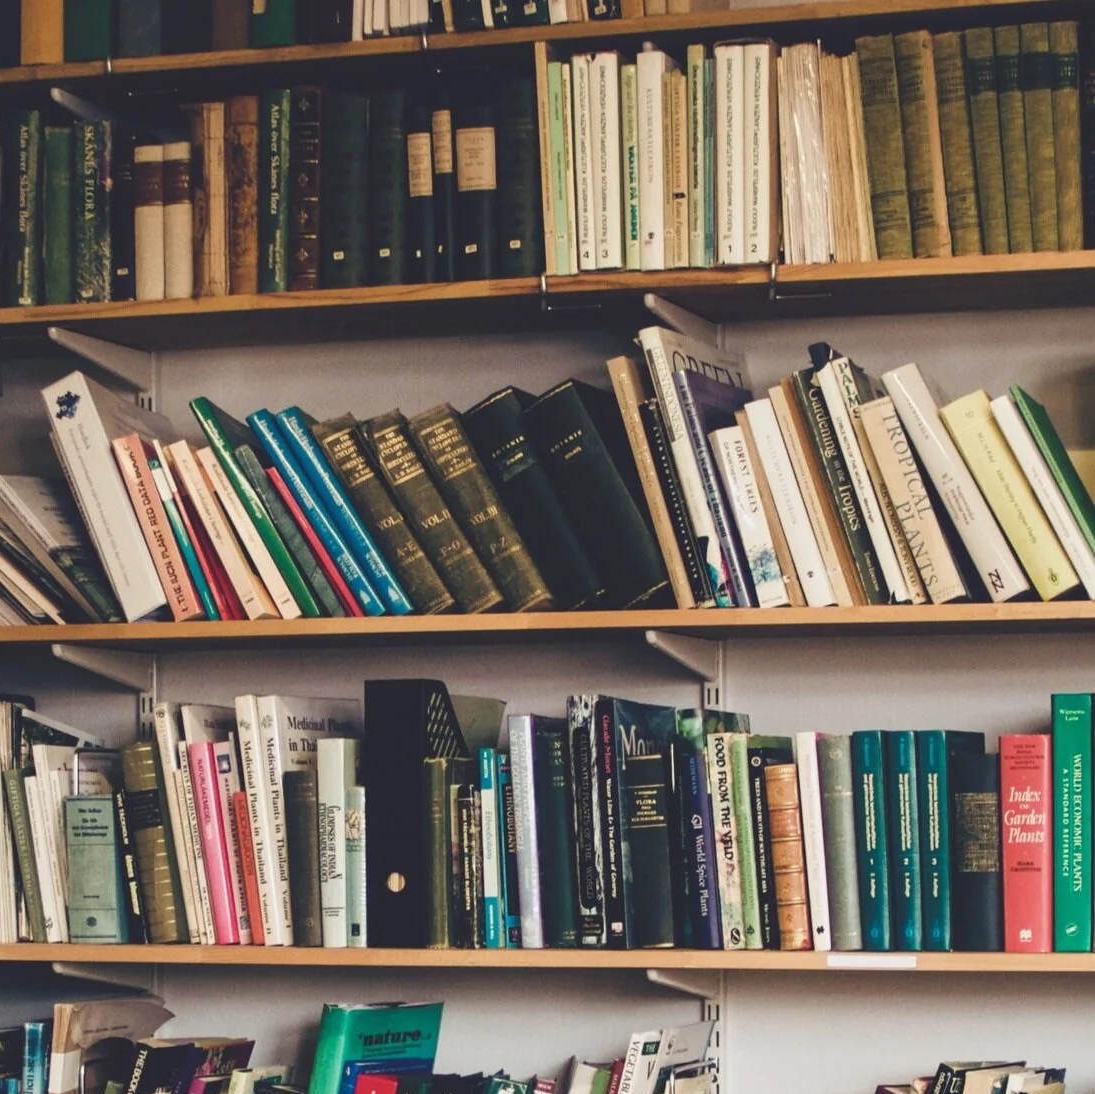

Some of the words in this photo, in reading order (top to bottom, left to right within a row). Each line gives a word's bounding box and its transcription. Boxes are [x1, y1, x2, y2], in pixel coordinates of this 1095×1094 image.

[270, 104, 280, 127] Atlas
[19, 125, 28, 148] Atlas
[85, 126, 95, 175] SKÅNES
[270, 131, 279, 152] över
[19, 151, 27, 171] över
[270, 155, 281, 189] Skånes
[19, 175, 29, 207] Skånes
[85, 179, 94, 220] FLORA
[270, 192, 280, 214] flora
[19, 210, 28, 232] flora
[804, 388, 840, 459] Gardening
[733, 440, 750, 477] FOREST
[744, 483, 758, 513] TREES
[836, 469, 847, 482] the
[881, 410, 932, 521] TROPICAL
[137, 480, 150, 505] DATA
[146, 507, 158, 526] RED
[838, 484, 864, 531] Tropics
[154, 529, 169, 559] PLANT
[894, 501, 938, 588] PLANTS
[287, 716, 328, 730] Medicinal
[602, 715, 611, 744] Claude
[243, 741, 257, 790] Medicinal
[266, 737, 279, 786] Medicinal
[714, 737, 725, 767] FOOD
[1073, 754, 1082, 792] WORLD
[185, 784, 191, 795] OF
[717, 772, 730, 803] FROM
[1009, 786, 1041, 802] Index
[248, 793, 260, 823] Plants
[271, 790, 283, 822] Plants
[506, 786, 515, 853] ETHNOBOTANY
[721, 806, 731, 828] THE
[1004, 811, 1045, 826] Garden
[251, 826, 260, 837] in
[274, 824, 283, 834] in
[326, 805, 341, 843] GLIMPSES
[485, 811, 493, 860] Ethnobotany
[584, 828, 592, 840] OF
[1008, 829, 1045, 843] Plants
[1073, 795, 1082, 849] ECONOMIC
[276, 839, 289, 882] Thailand
[327, 844, 336, 852] OF
[585, 842, 593, 861] THE
[695, 835, 706, 863] World
[722, 833, 734, 861] VELD
[253, 841, 267, 885] Thailand
[696, 864, 708, 887] Spice
[1073, 853, 1082, 891] PLANTS
[586, 867, 595, 899] WORLD
[699, 889, 710, 917] Plants
[135, 1050, 147, 1068] THE
[128, 1068, 142, 1093] BOOK
